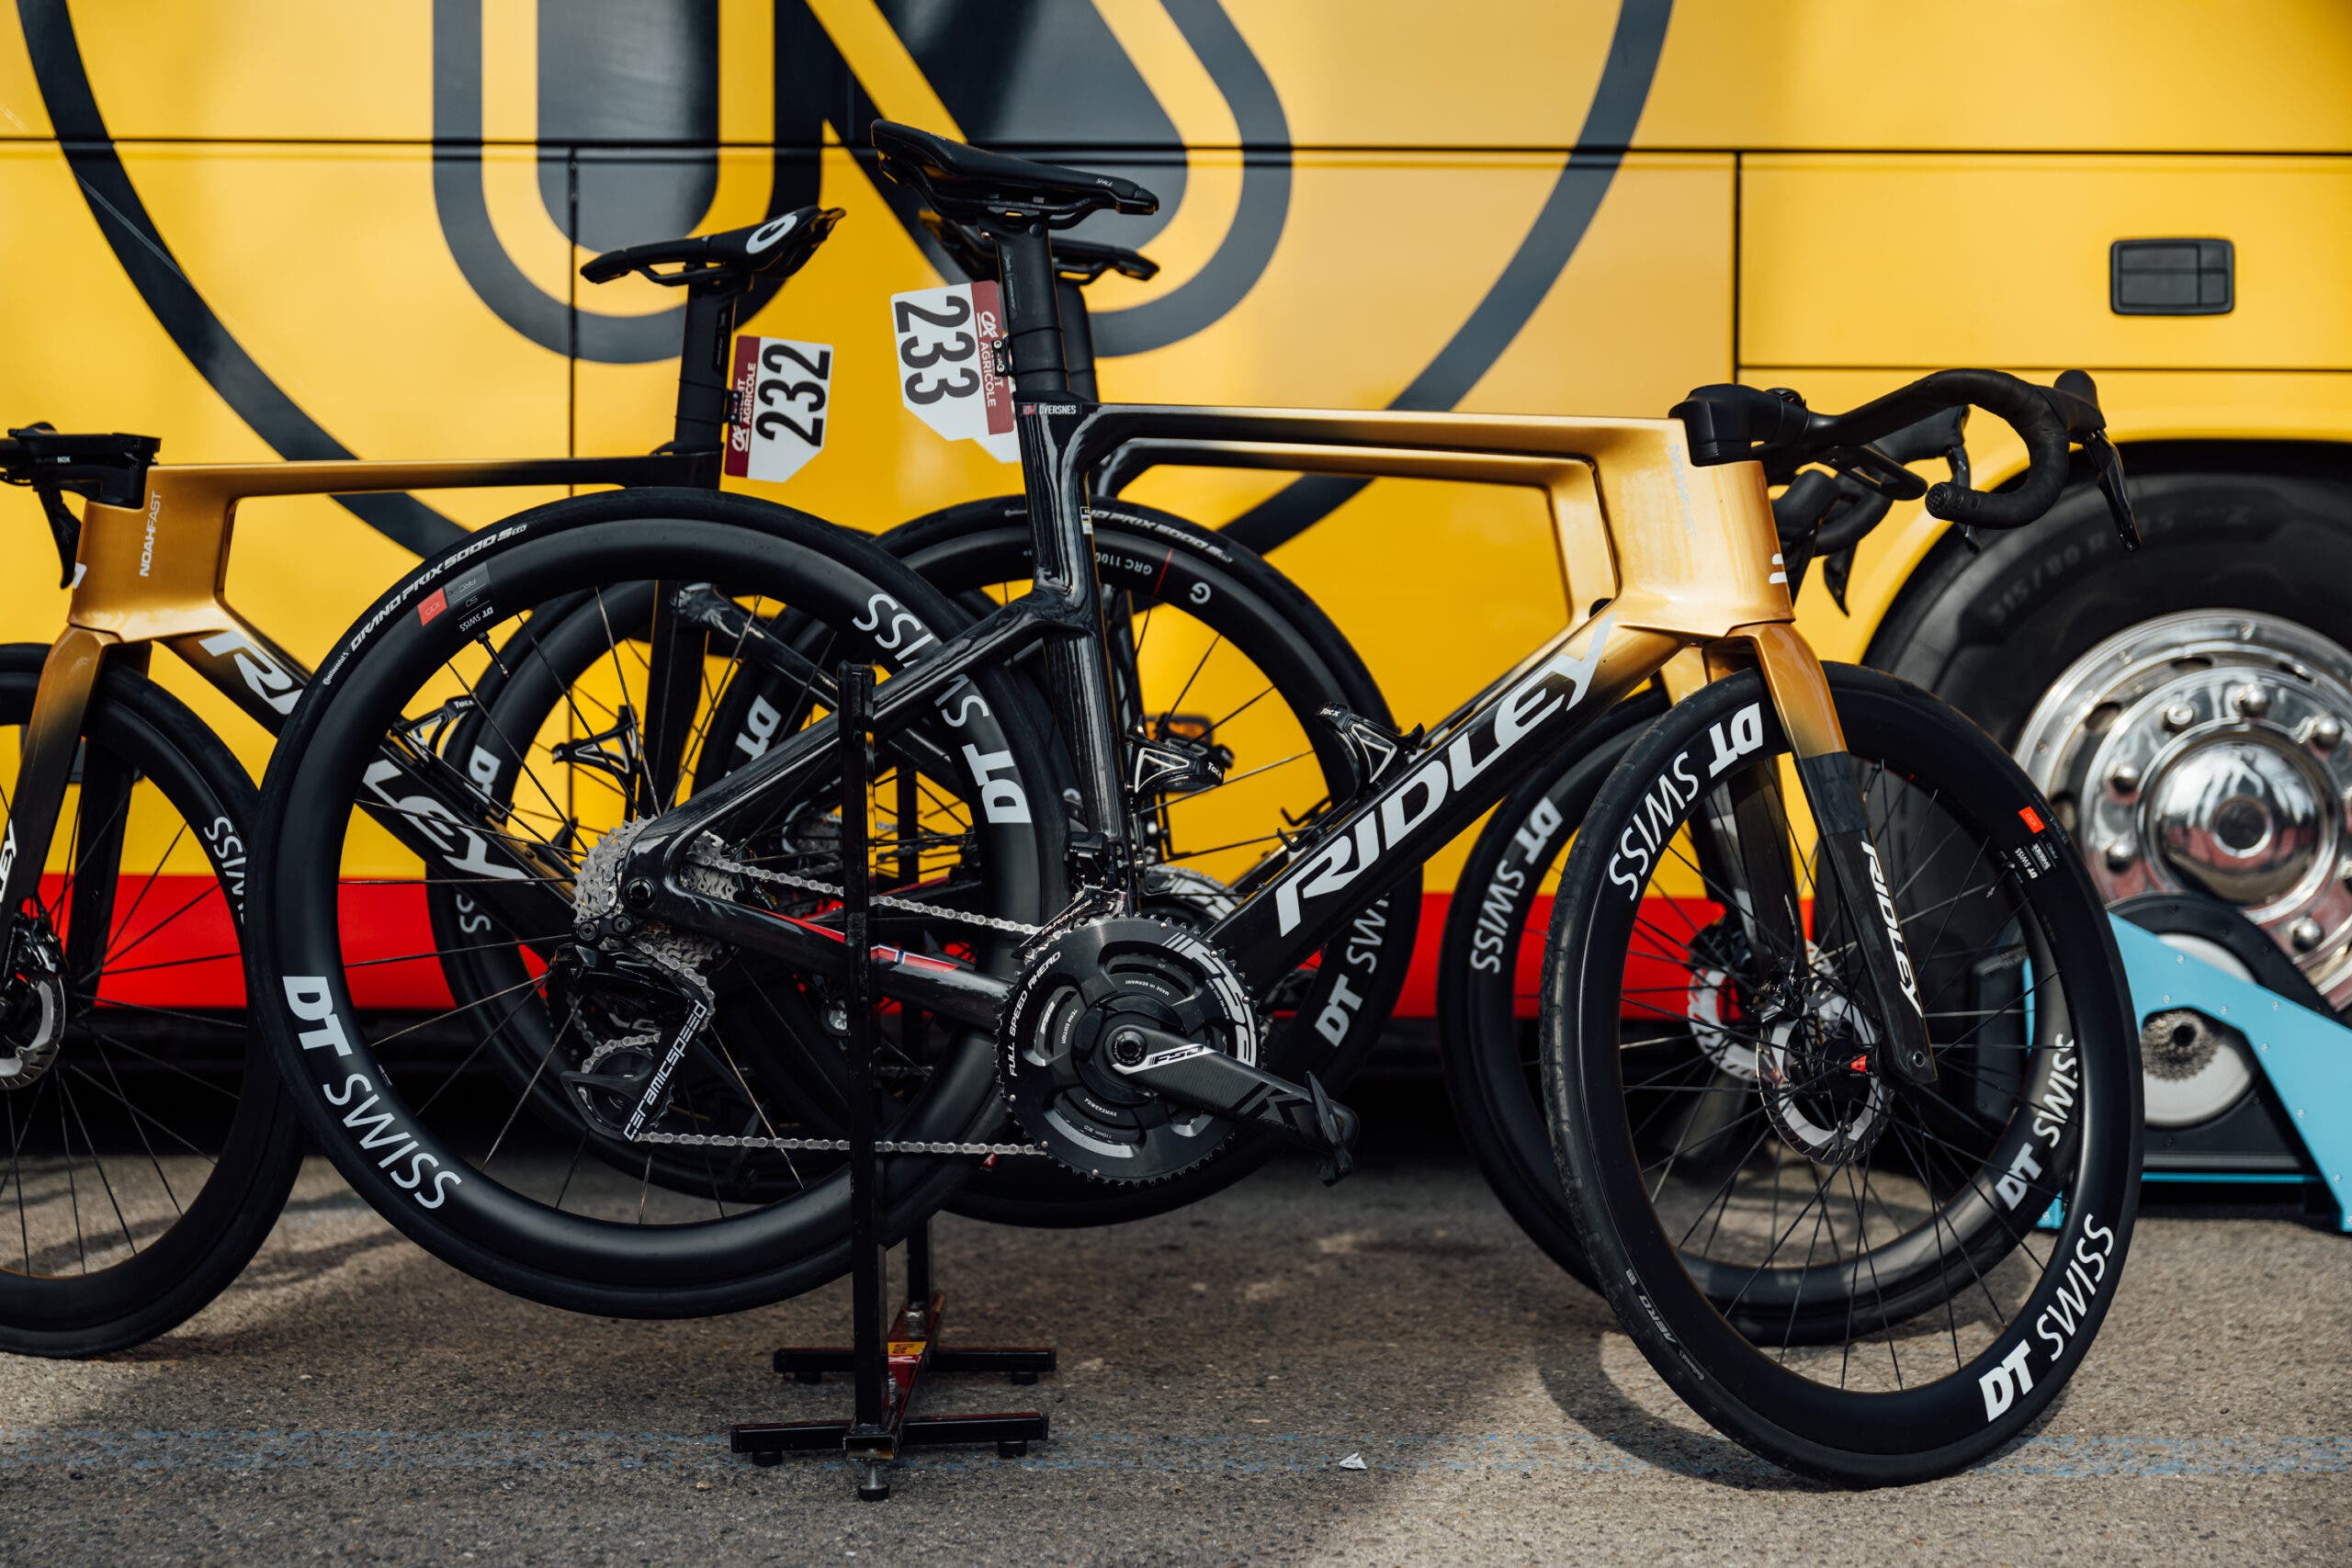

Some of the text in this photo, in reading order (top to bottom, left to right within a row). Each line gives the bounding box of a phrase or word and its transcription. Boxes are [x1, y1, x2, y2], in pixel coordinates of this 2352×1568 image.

[742, 362, 757, 425] AGRICOLE
[755, 344, 831, 447] 232
[894, 295, 981, 405] 233
[979, 341, 997, 408] AGRICOLE
[1108, 513, 1157, 530] PRIX
[1125, 558, 1153, 576] GRC
[351, 594, 401, 651] GRAND
[402, 562, 444, 600] PRIX
[444, 536, 497, 570] 5000
[459, 605, 495, 632] DT SWISS
[962, 743, 1032, 824] DT
[1274, 610, 1616, 938] RIDLEY
[1609, 702, 1764, 902] DT SWISS
[1470, 795, 1564, 975] DT SWISS
[1860, 840, 1924, 1019] RIDLEY
[1007, 951, 1061, 1077] FULL SPEED AHEAD
[1314, 973, 1363, 1048] DT
[282, 976, 462, 1209] DT SWISS
[1995, 1032, 2078, 1212] DT SWISS
[1978, 1213, 2114, 1422] DT SWISS
